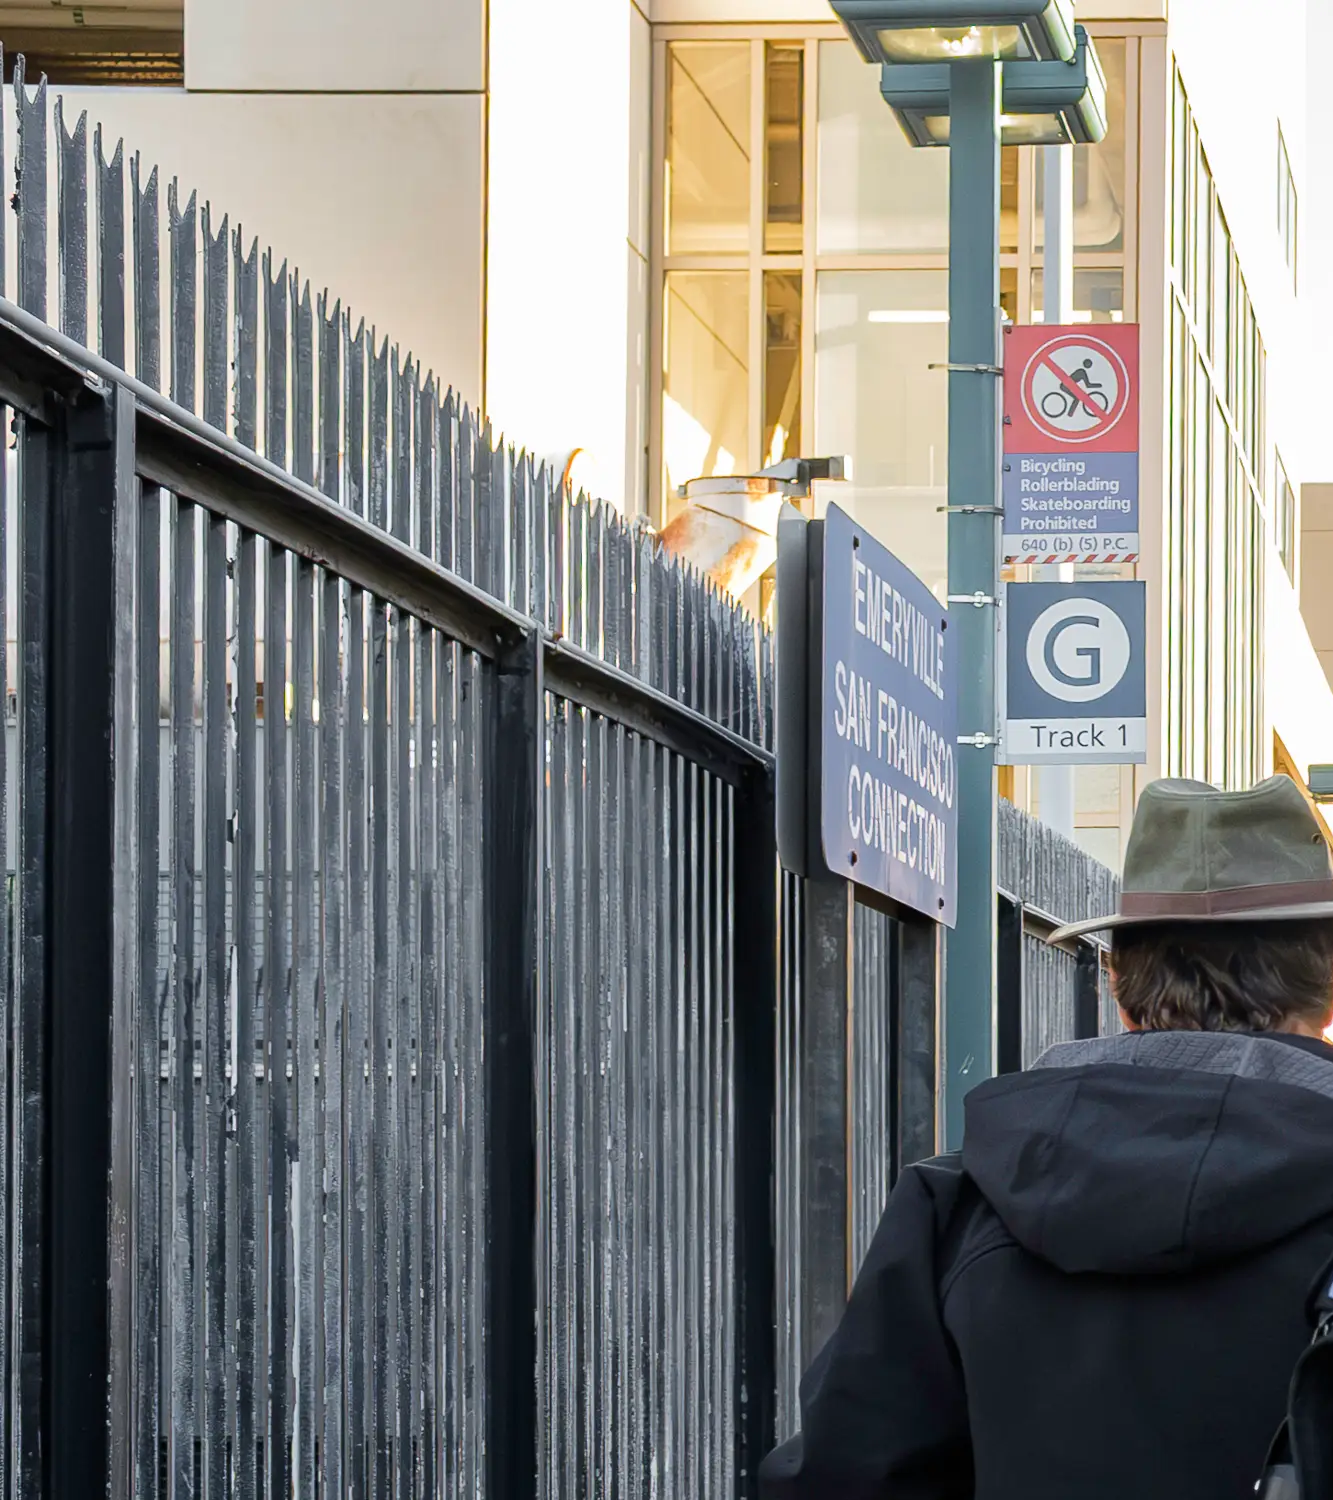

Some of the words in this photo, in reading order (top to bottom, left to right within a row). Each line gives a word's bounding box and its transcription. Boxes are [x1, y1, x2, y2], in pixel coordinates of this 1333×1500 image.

[1020, 458, 1086, 475] Bicycling
[1020, 477, 1120, 494] Rollerblading
[1020, 496, 1131, 513] Skateboarding
[1020, 515, 1097, 530] Prohibited
[1021, 538, 1048, 551] 640
[1053, 536, 1073, 552] (b)
[1079, 536, 1098, 552] (5)
[1103, 537, 1129, 550] P.C.
[853, 557, 945, 700] EMERYVILLE
[1043, 615, 1101, 687] G
[834, 660, 871, 752] SAN
[876, 689, 954, 809] FRANCISCO
[1030, 723, 1105, 748] Track
[1117, 724, 1129, 747] 1
[847, 764, 946, 886] CONNECTION
